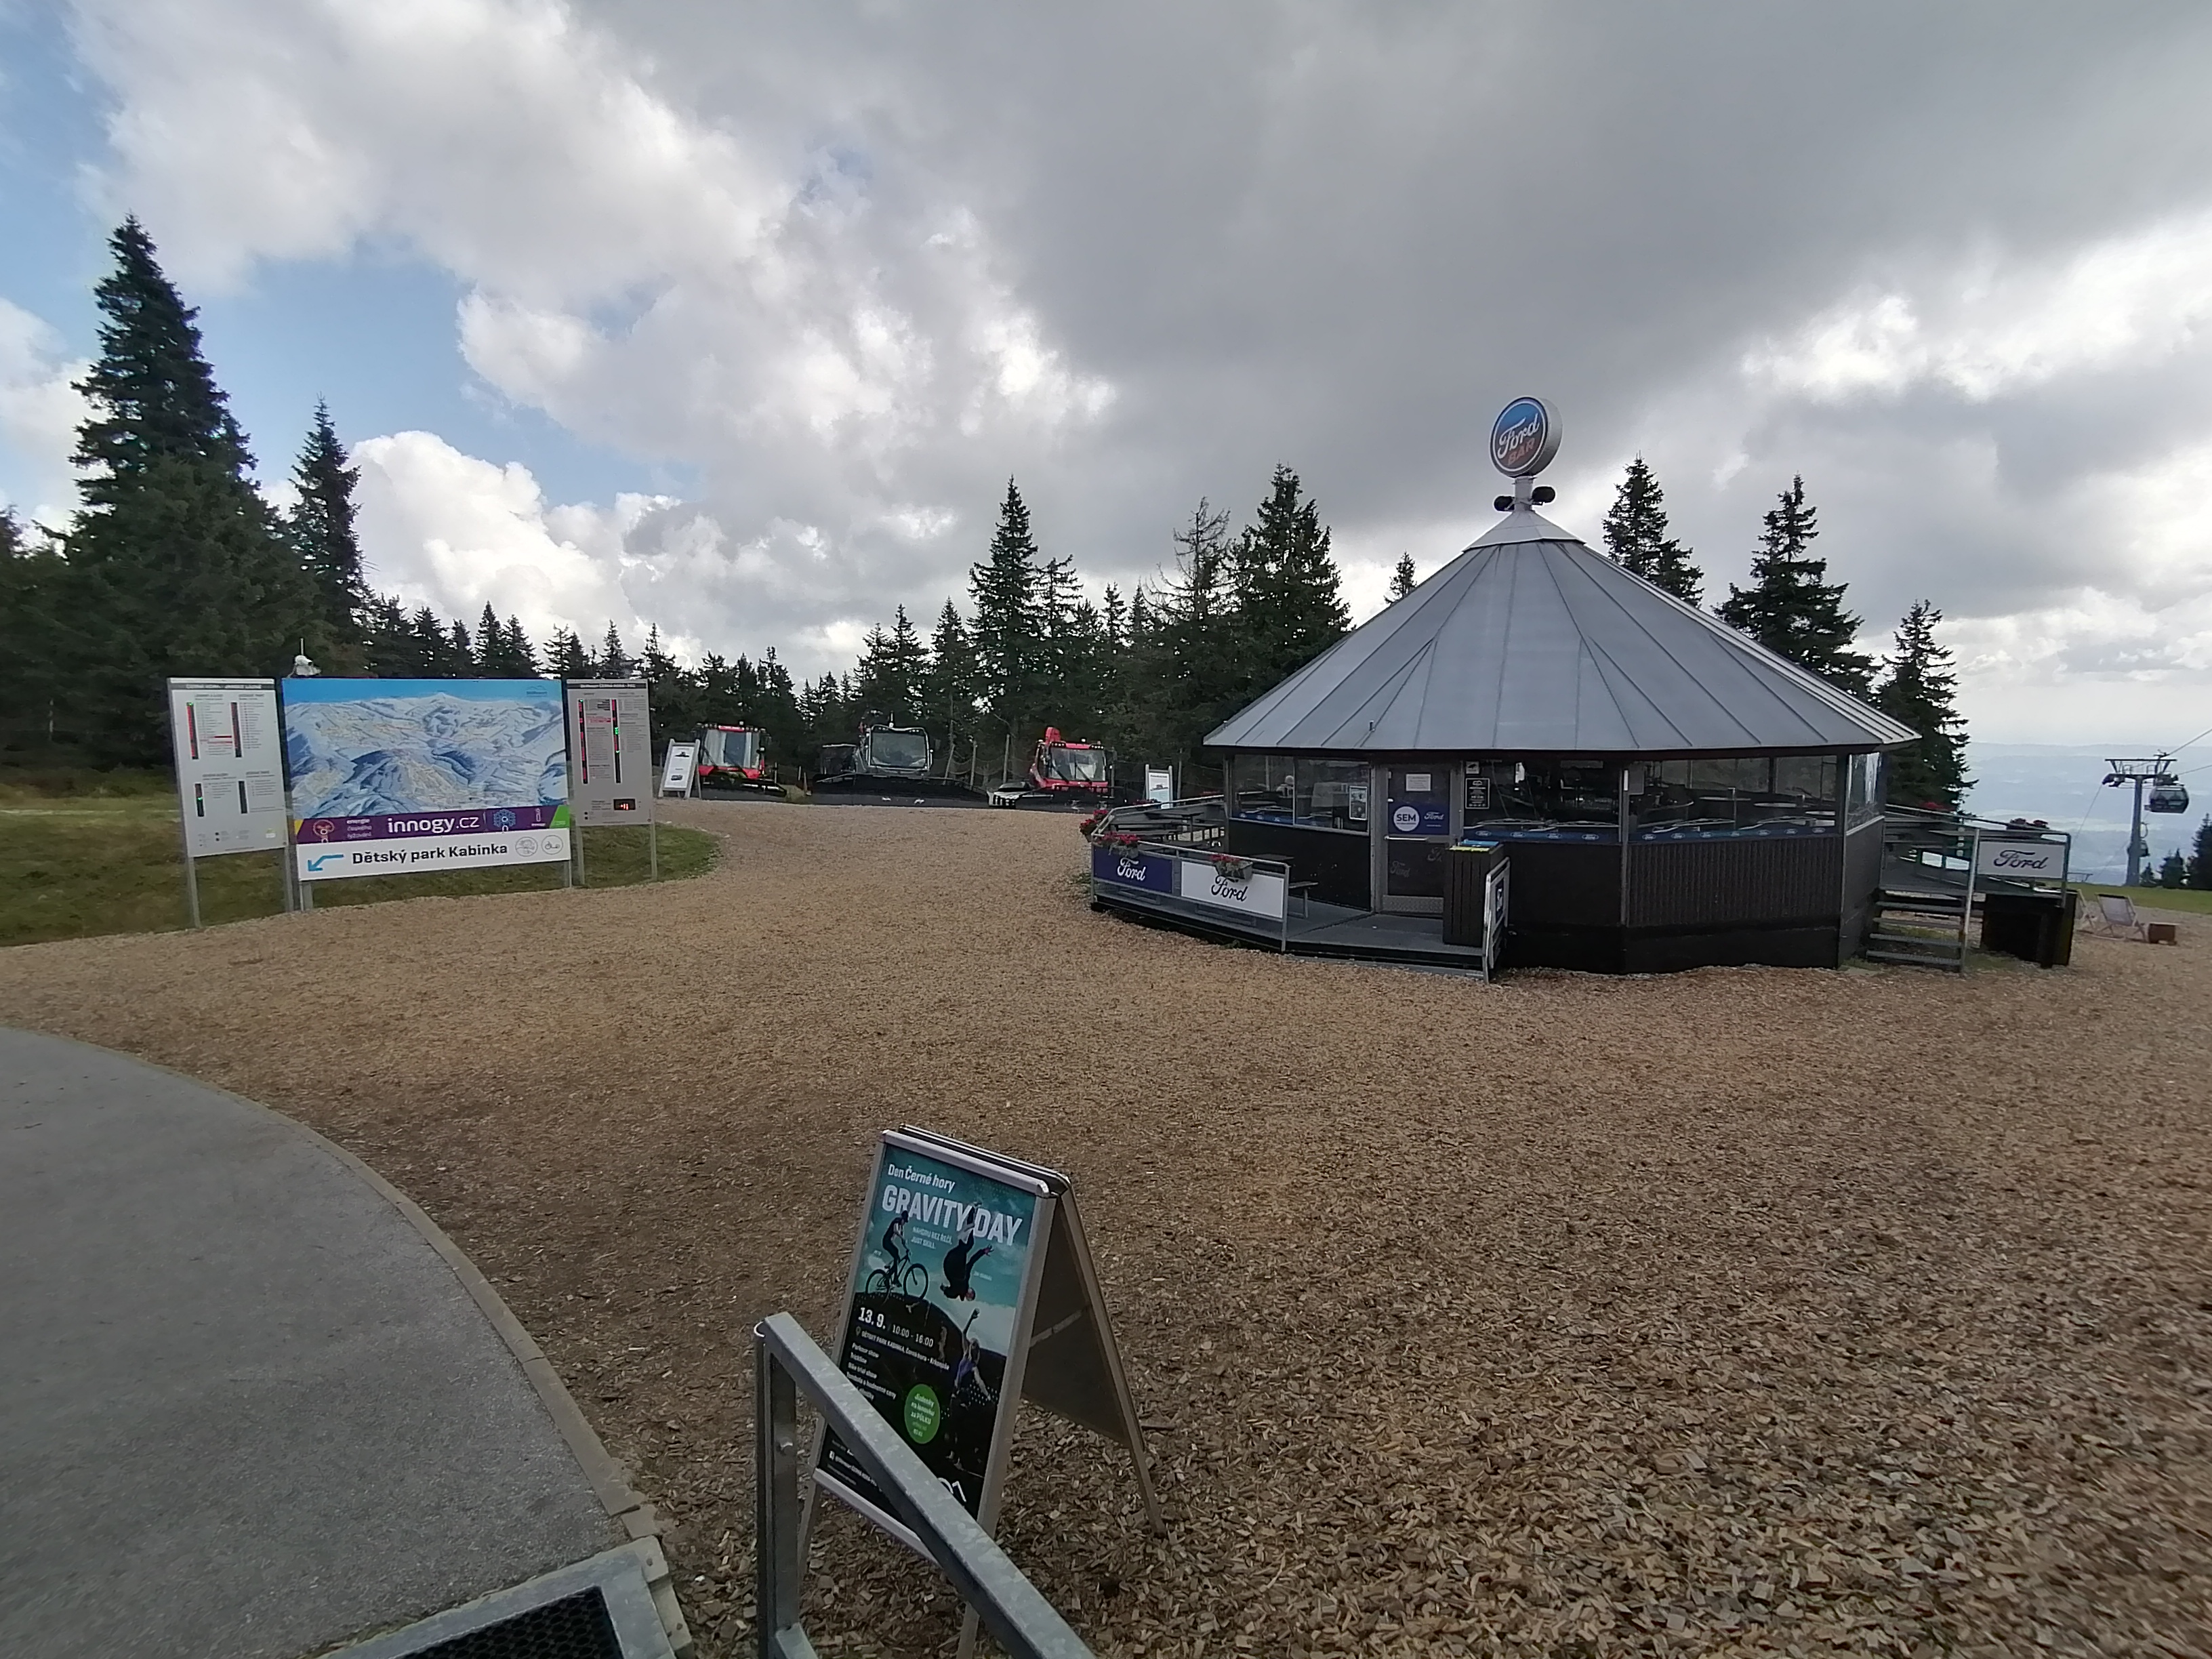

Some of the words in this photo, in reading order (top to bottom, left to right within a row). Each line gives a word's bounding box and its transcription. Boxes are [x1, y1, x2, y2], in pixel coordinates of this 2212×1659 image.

[1497, 413, 1540, 459] Ford
[1507, 437, 1536, 466] BAR
[387, 817, 480, 834] innogy.cz
[1424, 811, 1444, 820] Ford
[352, 849, 407, 864] Dětský
[411, 848, 446, 862] park
[449, 843, 508, 857] Kabinka
[1994, 849, 2049, 869] Ford
[1117, 857, 1146, 881] Ford
[1211, 875, 1248, 902] Ford
[888, 1164, 903, 1179] Den
[905, 1165, 933, 1185] Černé
[933, 1174, 956, 1193] hory
[882, 1185, 972, 1232] GRAVITY
[973, 1208, 1023, 1246] DAY
